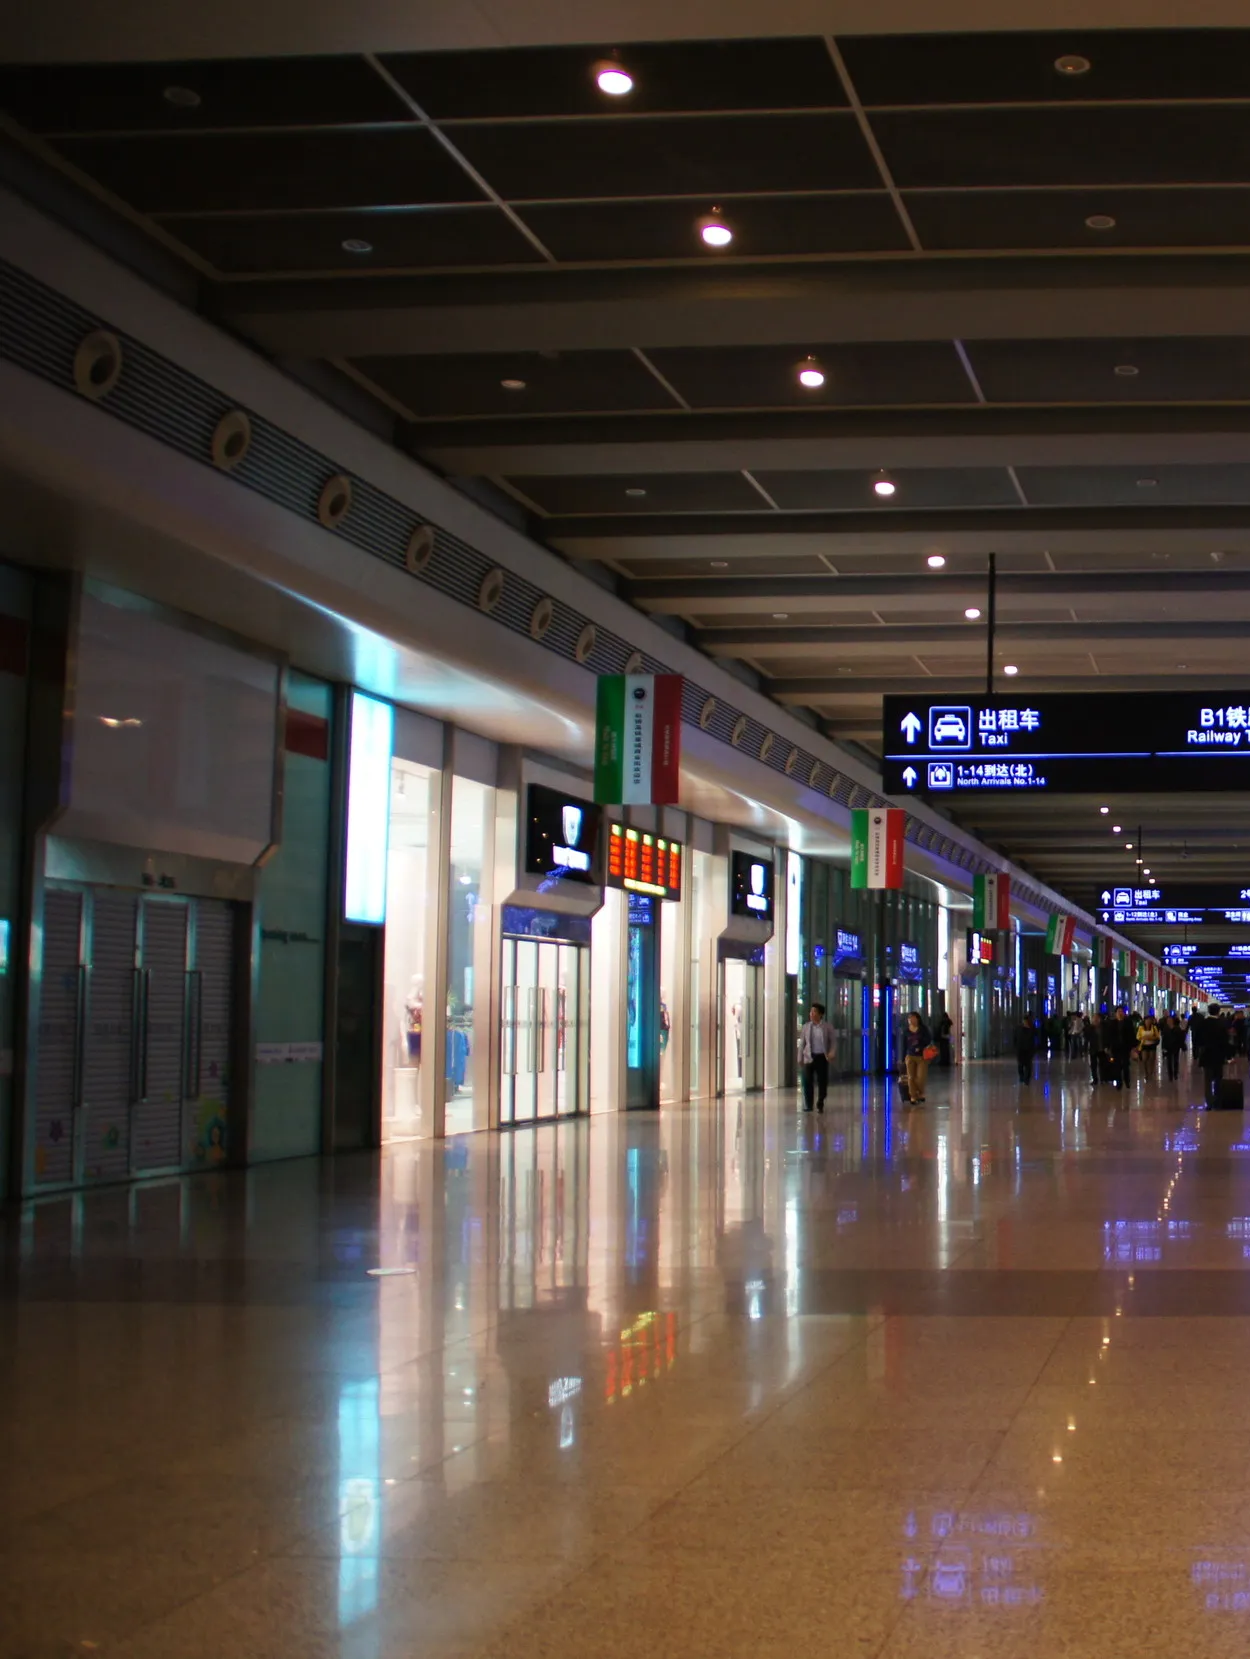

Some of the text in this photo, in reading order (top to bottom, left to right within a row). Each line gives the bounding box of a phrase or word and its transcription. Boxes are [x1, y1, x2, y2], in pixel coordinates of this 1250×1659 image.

[978, 708, 1040, 731] 出租车
[978, 732, 1008, 745] Taxi
[1187, 729, 1242, 746] Railway
[957, 777, 980, 786] North
[981, 777, 1012, 786] Arrivals
[1134, 889, 1161, 900] 出租车
